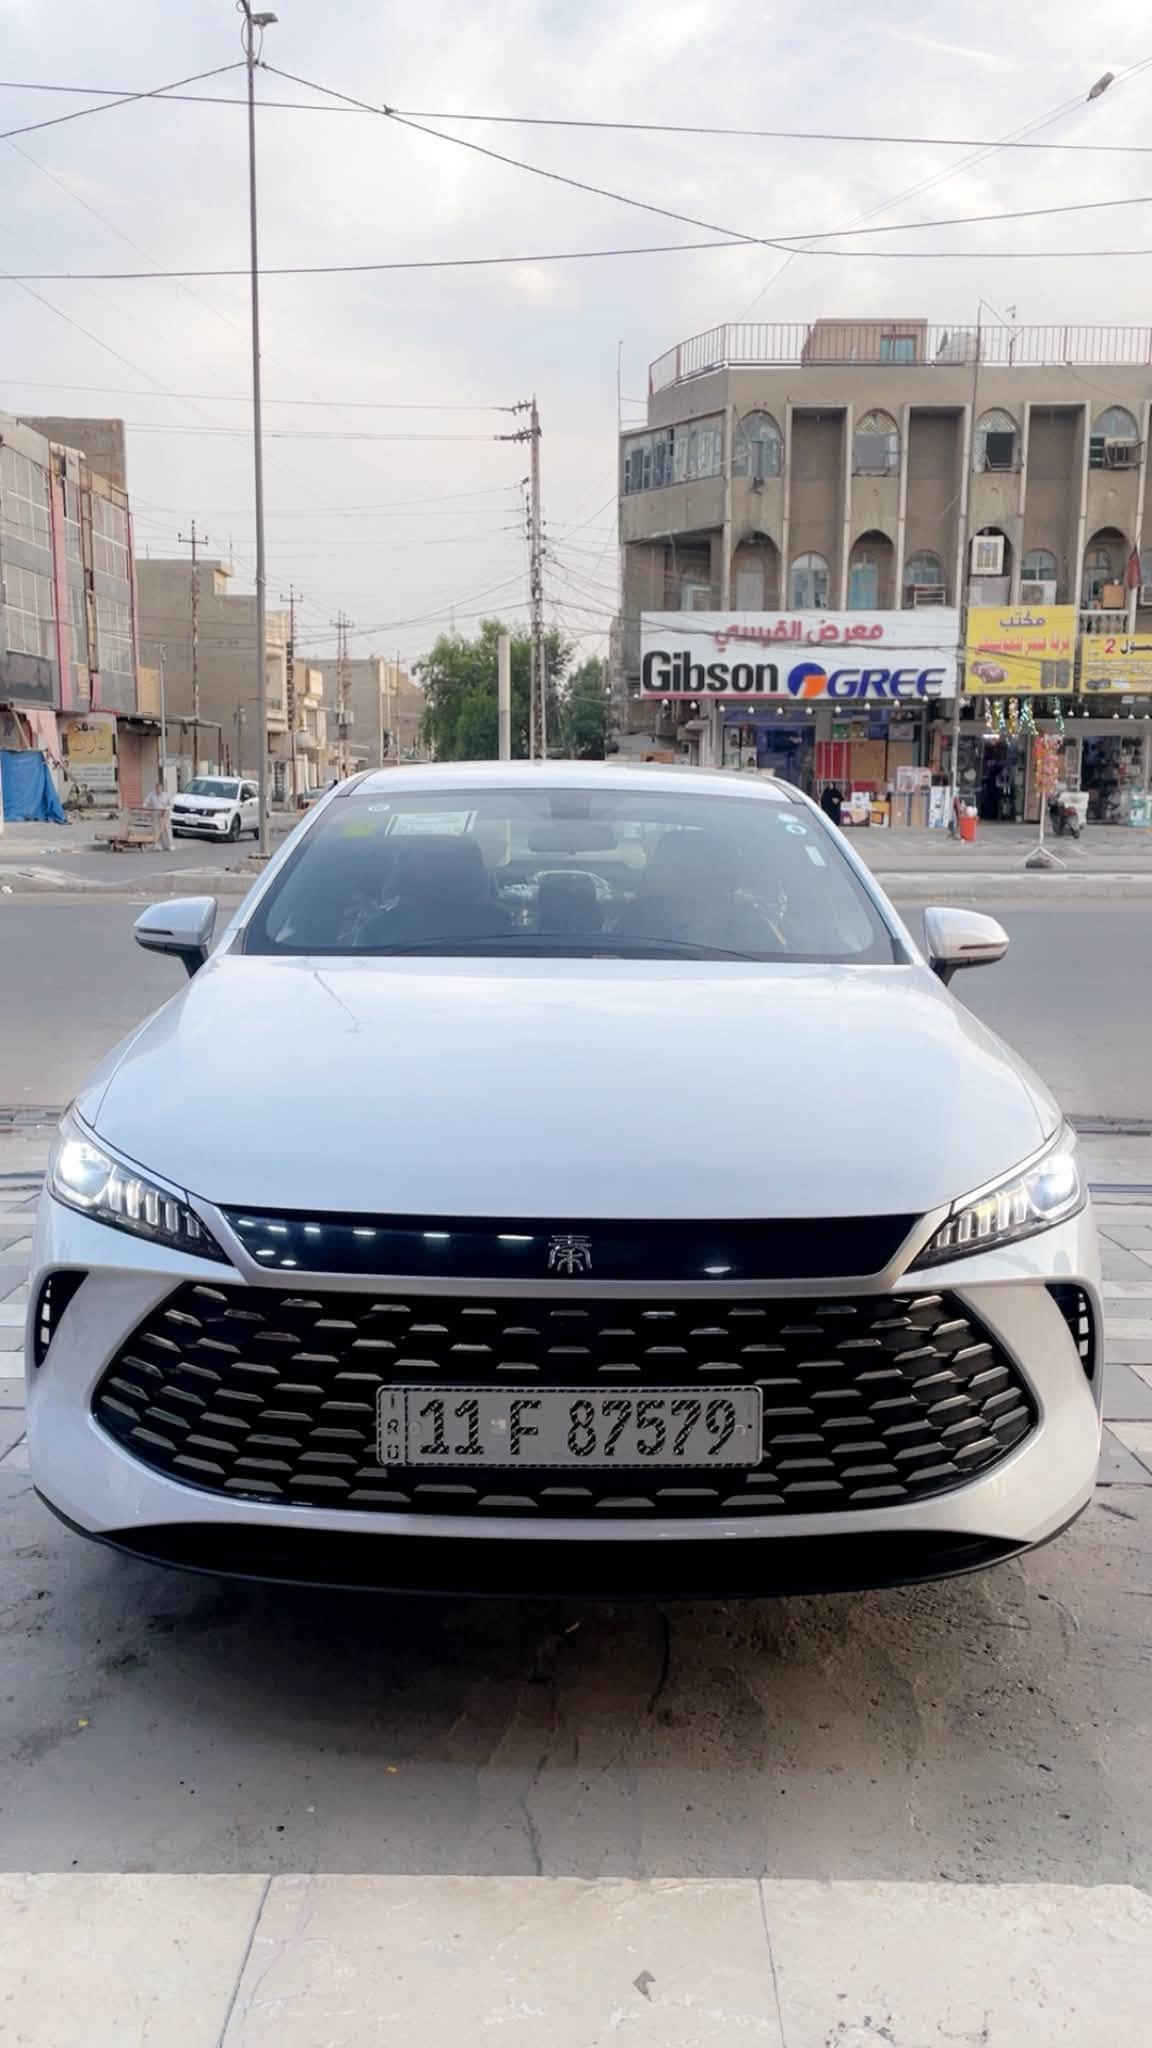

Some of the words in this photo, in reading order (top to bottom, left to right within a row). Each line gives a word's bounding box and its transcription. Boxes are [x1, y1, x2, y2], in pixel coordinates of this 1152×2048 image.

[714, 620, 802, 652] القيسي
[808, 619, 884, 644] معرض
[1104, 638, 1117, 654] 2
[642, 650, 778, 693] Gibson
[827, 668, 947, 698] GREE
[420, 1400, 484, 1455] 11
[510, 1400, 543, 1455] F
[567, 1400, 736, 1457] 87579
